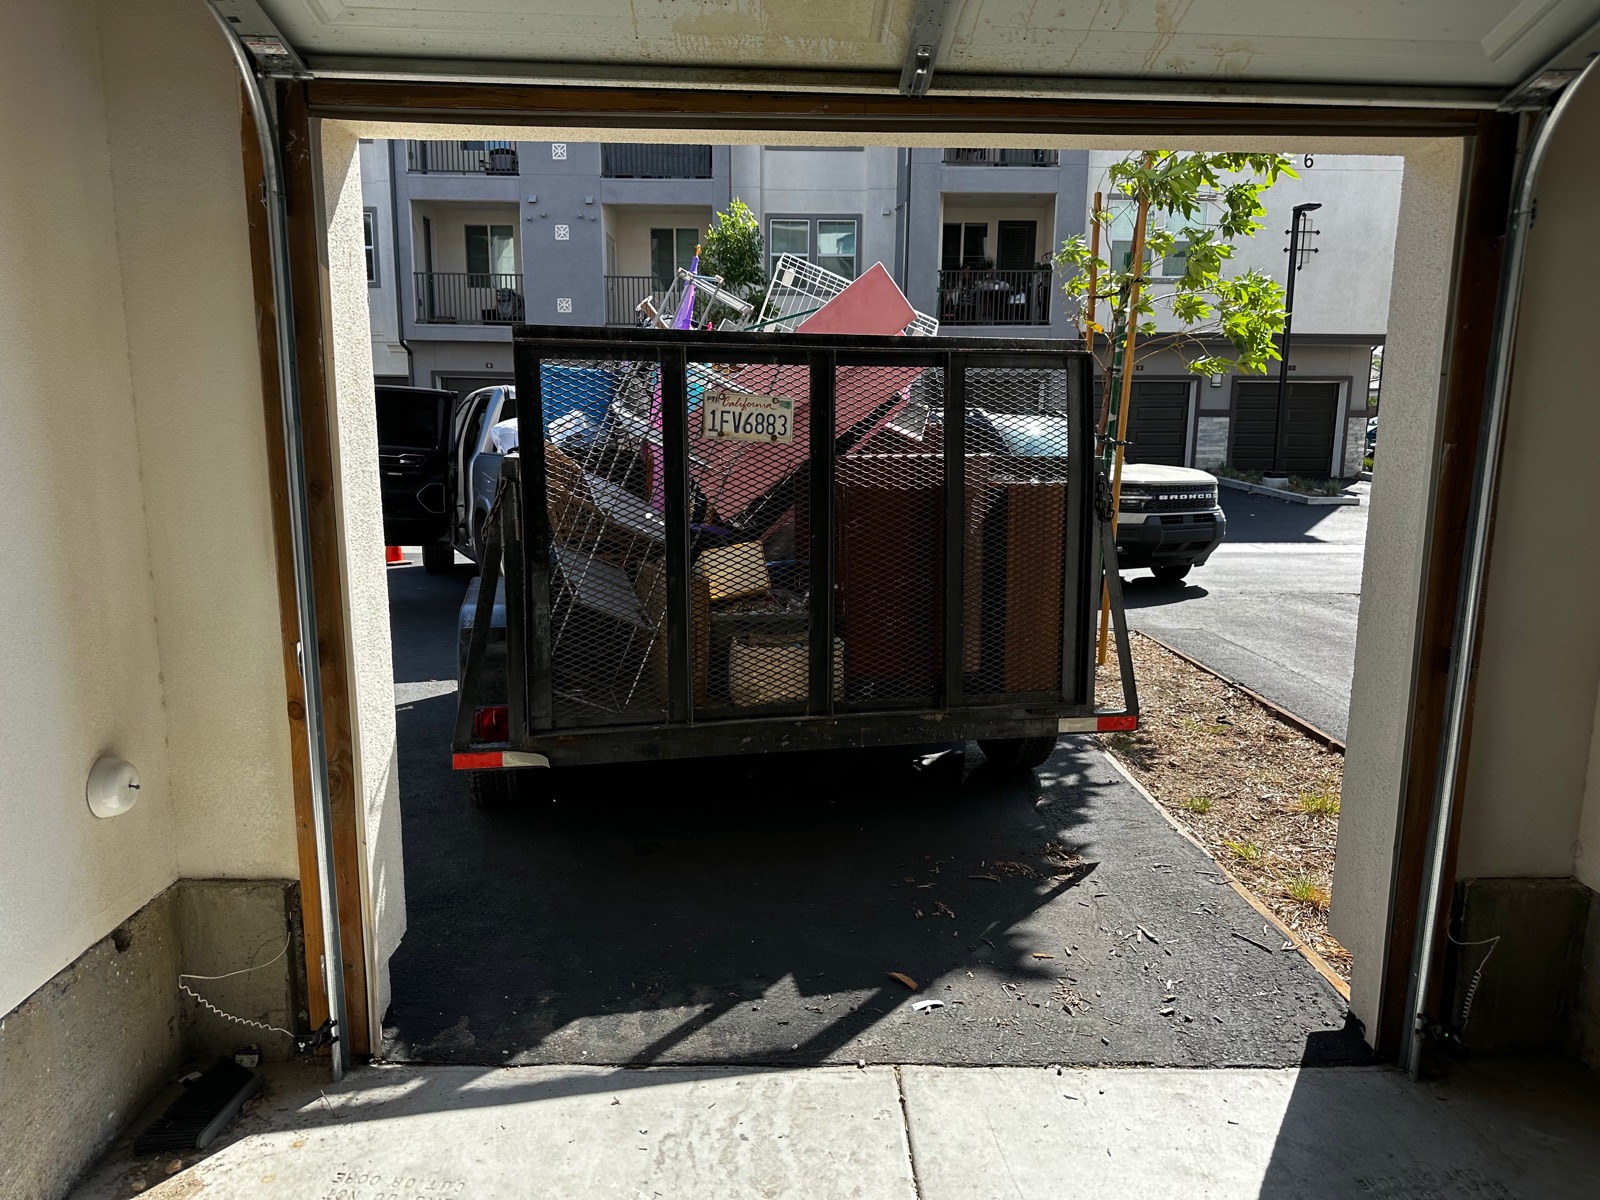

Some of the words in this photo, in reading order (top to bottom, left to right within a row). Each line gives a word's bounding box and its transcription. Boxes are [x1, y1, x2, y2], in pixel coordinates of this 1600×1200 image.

[1304, 153, 1314, 168] 6
[722, 397, 777, 411] California
[708, 410, 787, 436] 1FV6883
